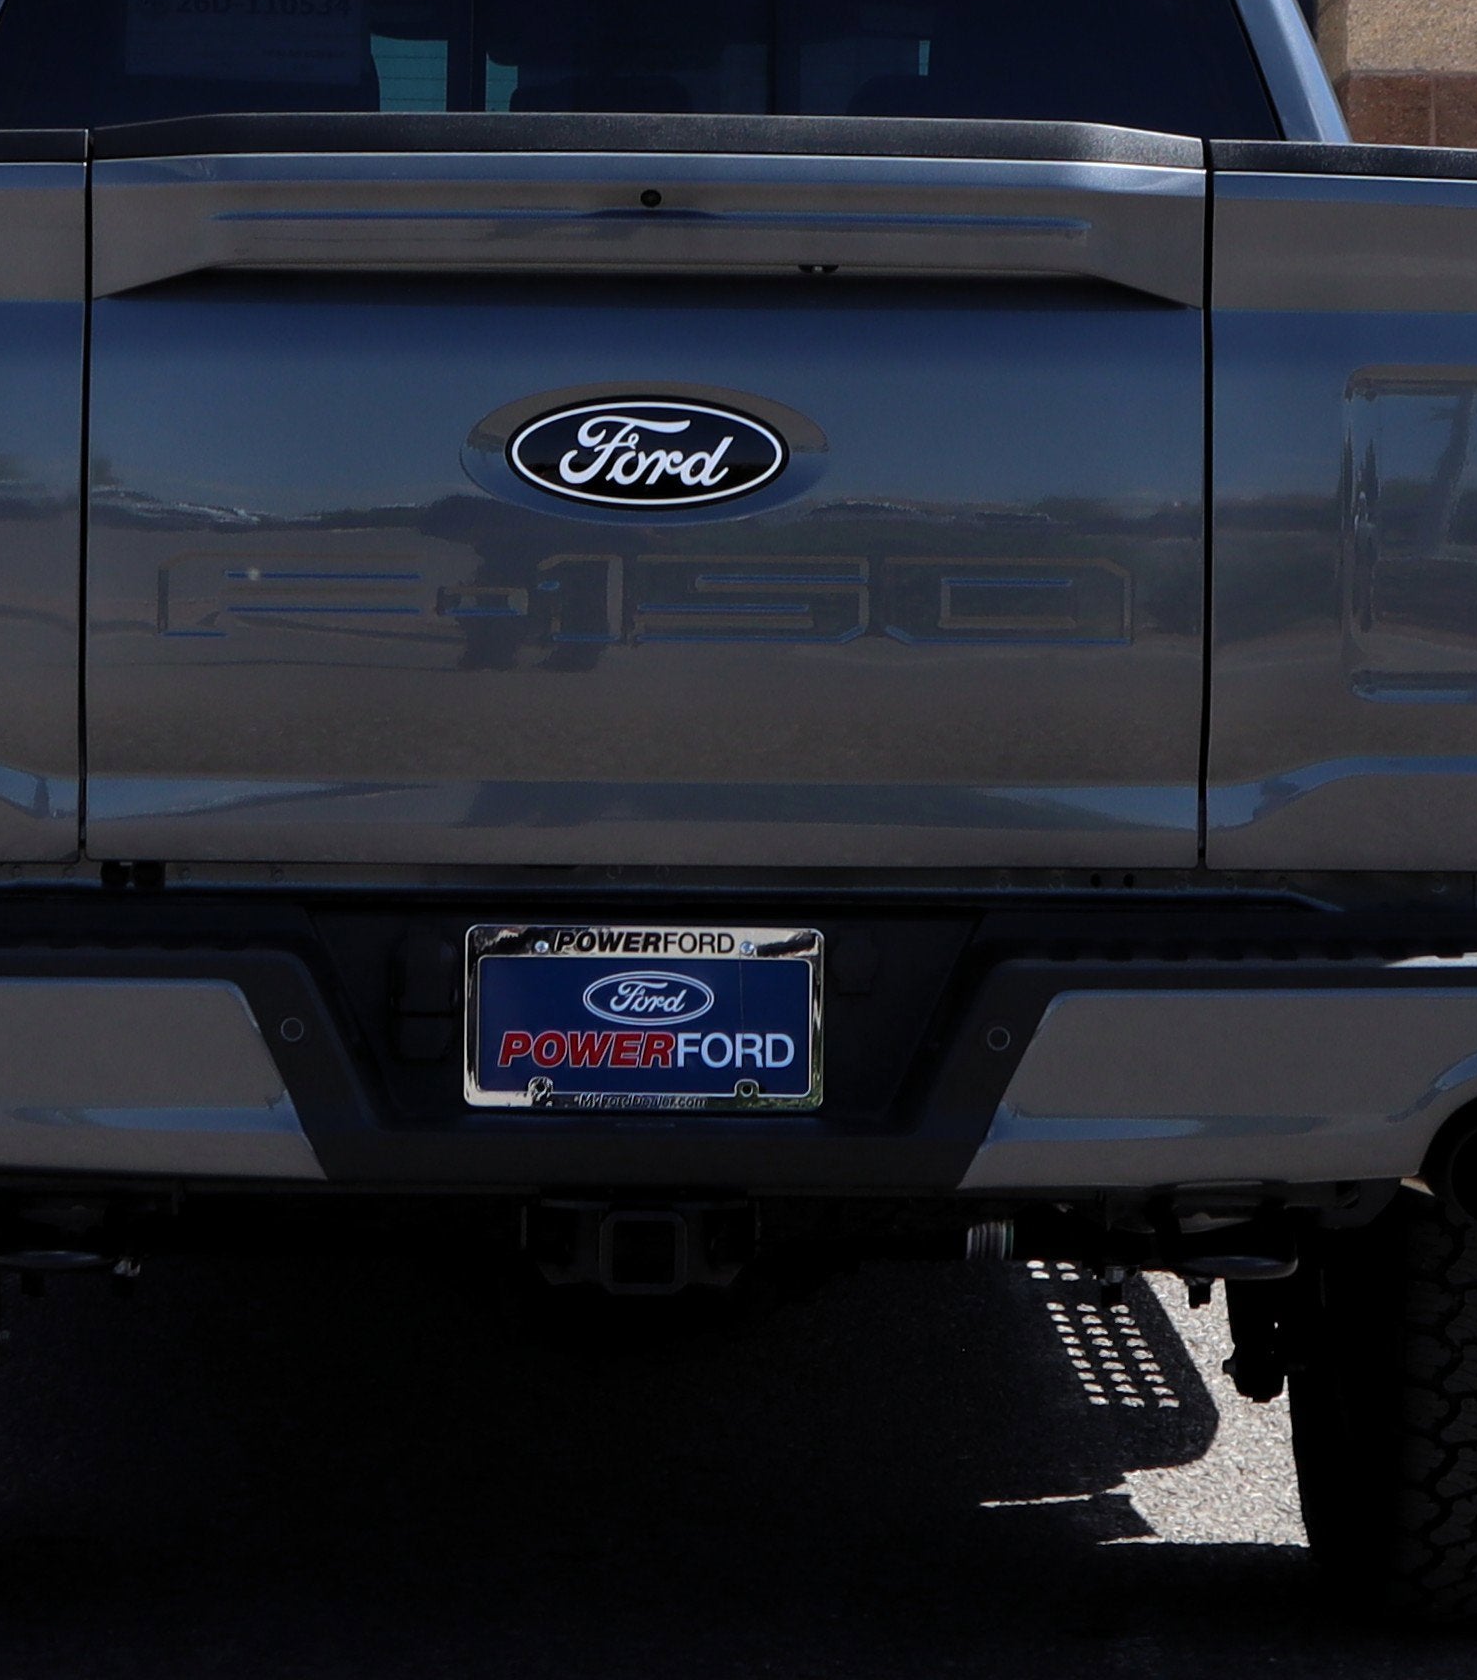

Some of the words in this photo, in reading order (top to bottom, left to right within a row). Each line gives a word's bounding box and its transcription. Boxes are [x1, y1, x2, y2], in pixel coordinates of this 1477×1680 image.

[558, 415, 735, 487] Ford
[554, 931, 735, 954] POWERFORD
[609, 980, 689, 1012] Ford
[497, 1030, 795, 1069] POWERFORD
